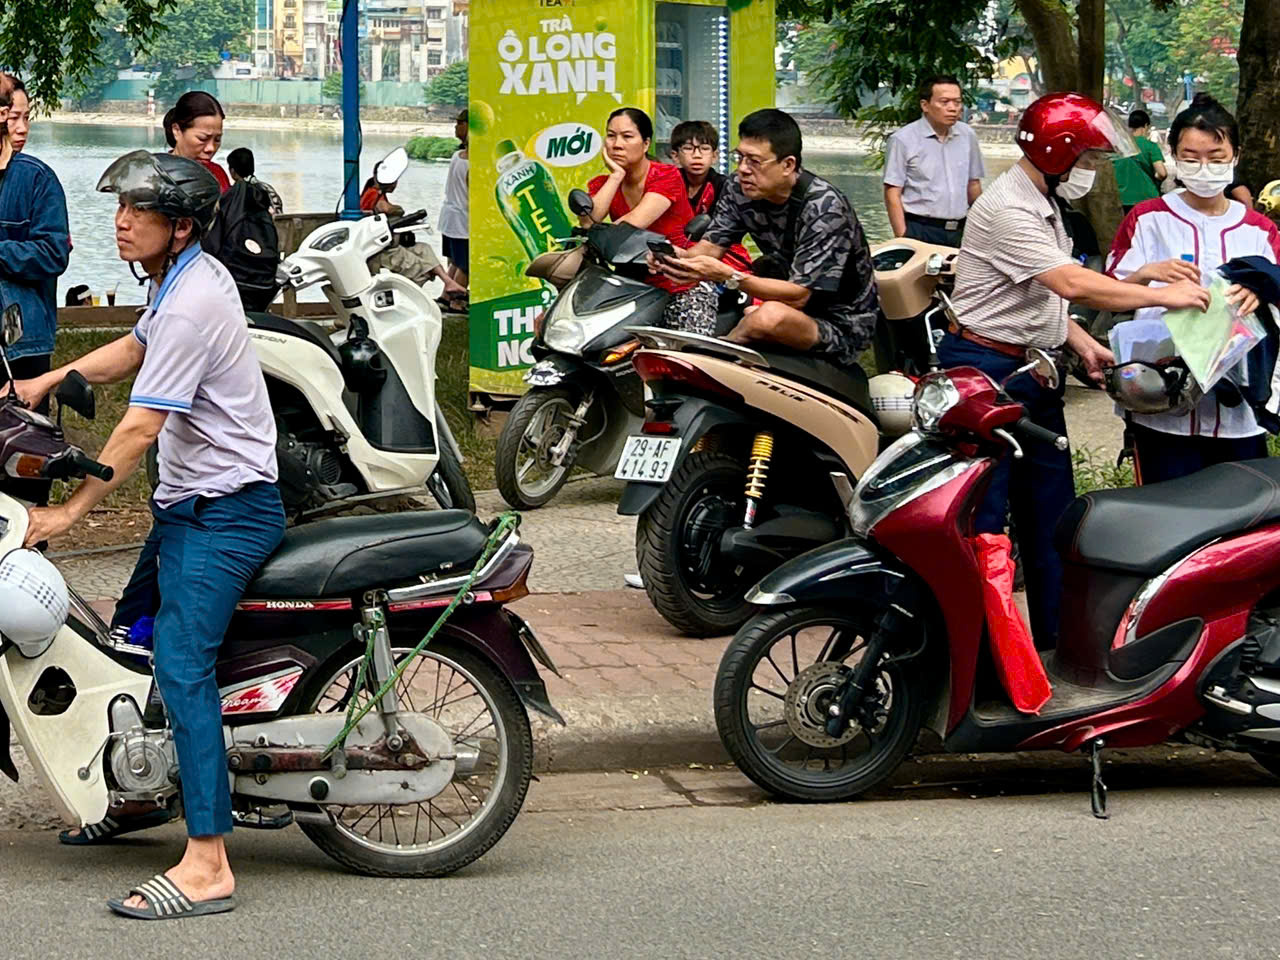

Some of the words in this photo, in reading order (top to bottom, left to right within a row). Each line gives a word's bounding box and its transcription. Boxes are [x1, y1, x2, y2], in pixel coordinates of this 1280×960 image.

[539, 14, 573, 33] TRÀ
[498, 29, 523, 62] Ô
[528, 32, 616, 61] LONG
[499, 60, 617, 95] XANH
[546, 127, 593, 159] MỚI
[504, 166, 535, 189] XANH
[630, 439, 671, 458] 29-AF
[266, 601, 315, 609] HONDA
